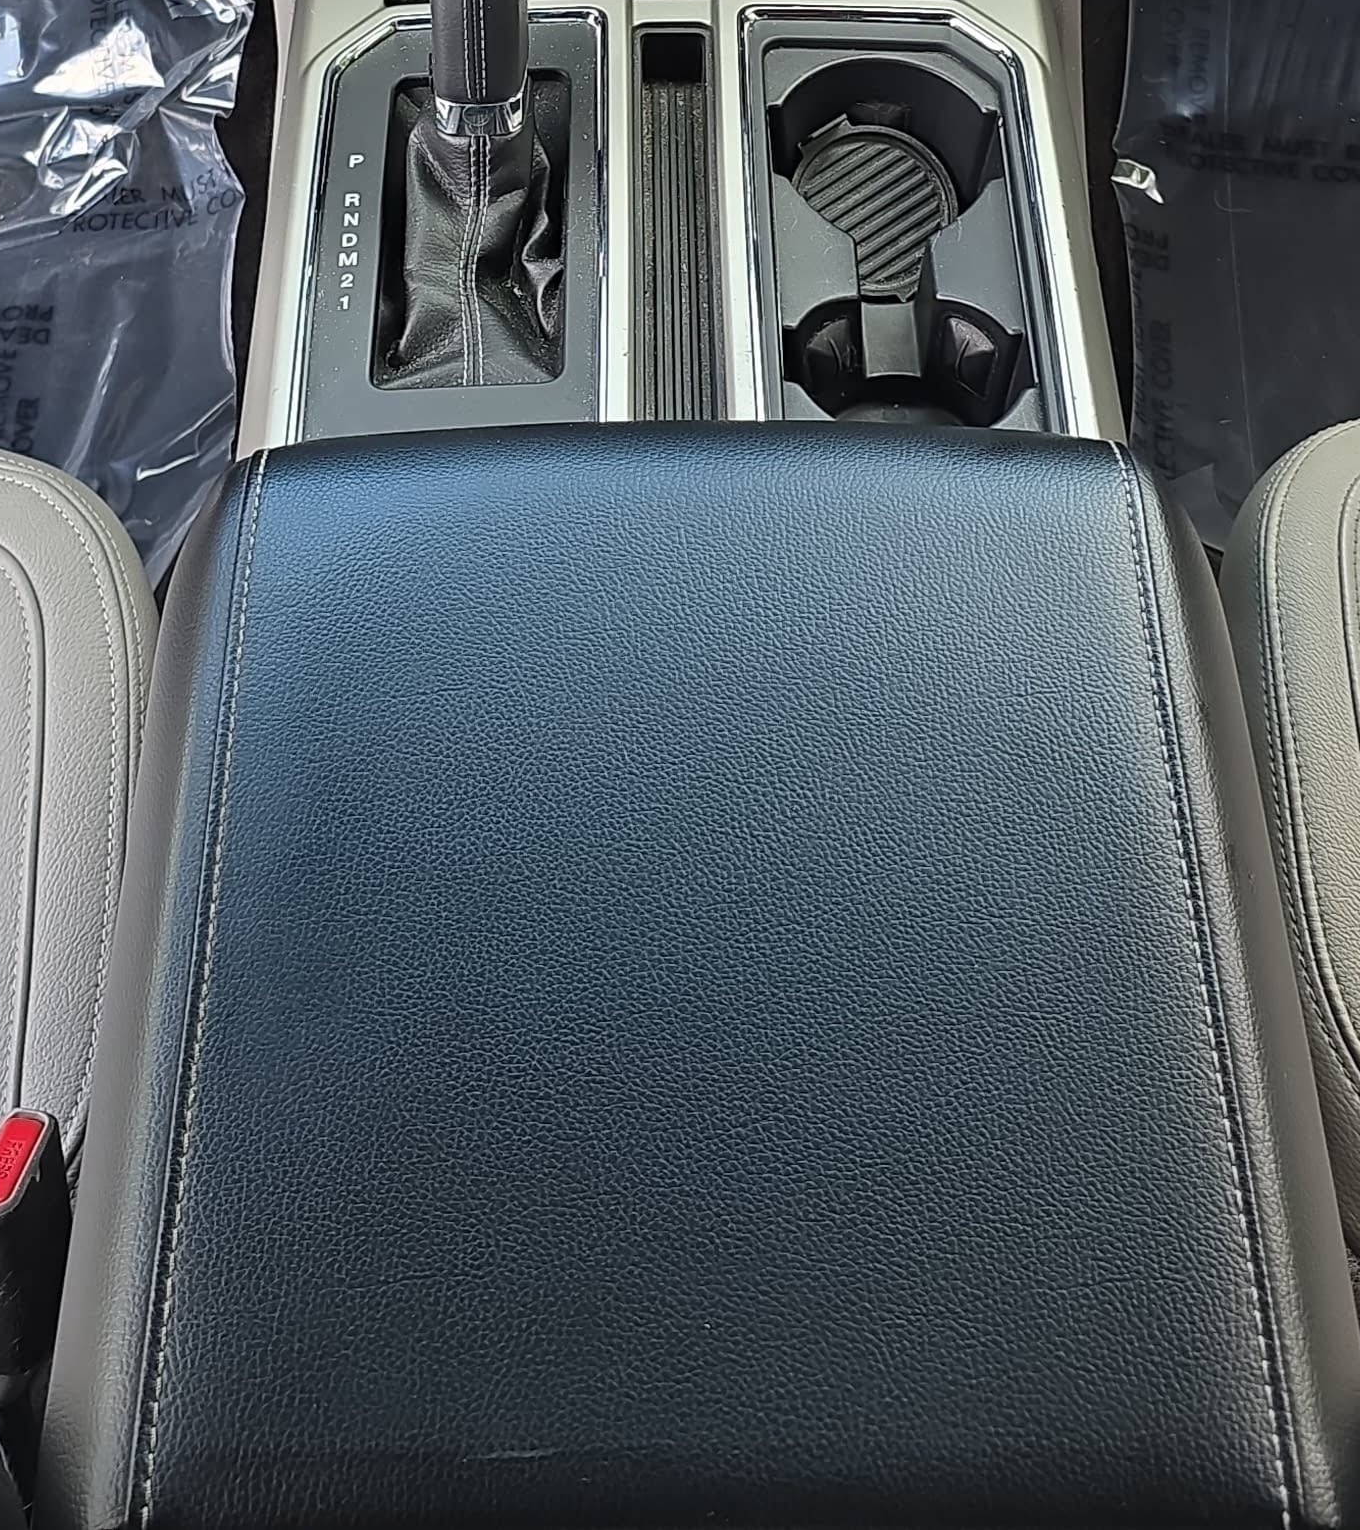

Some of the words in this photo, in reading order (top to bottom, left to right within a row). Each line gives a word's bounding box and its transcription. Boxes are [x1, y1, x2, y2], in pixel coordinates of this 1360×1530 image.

[348, 154, 366, 169] P
[343, 192, 361, 207] R
[342, 212, 360, 227] N
[341, 233, 358, 247] D
[338, 252, 359, 267] M
[339, 273, 354, 288] 2
[339, 295, 351, 310] 1
